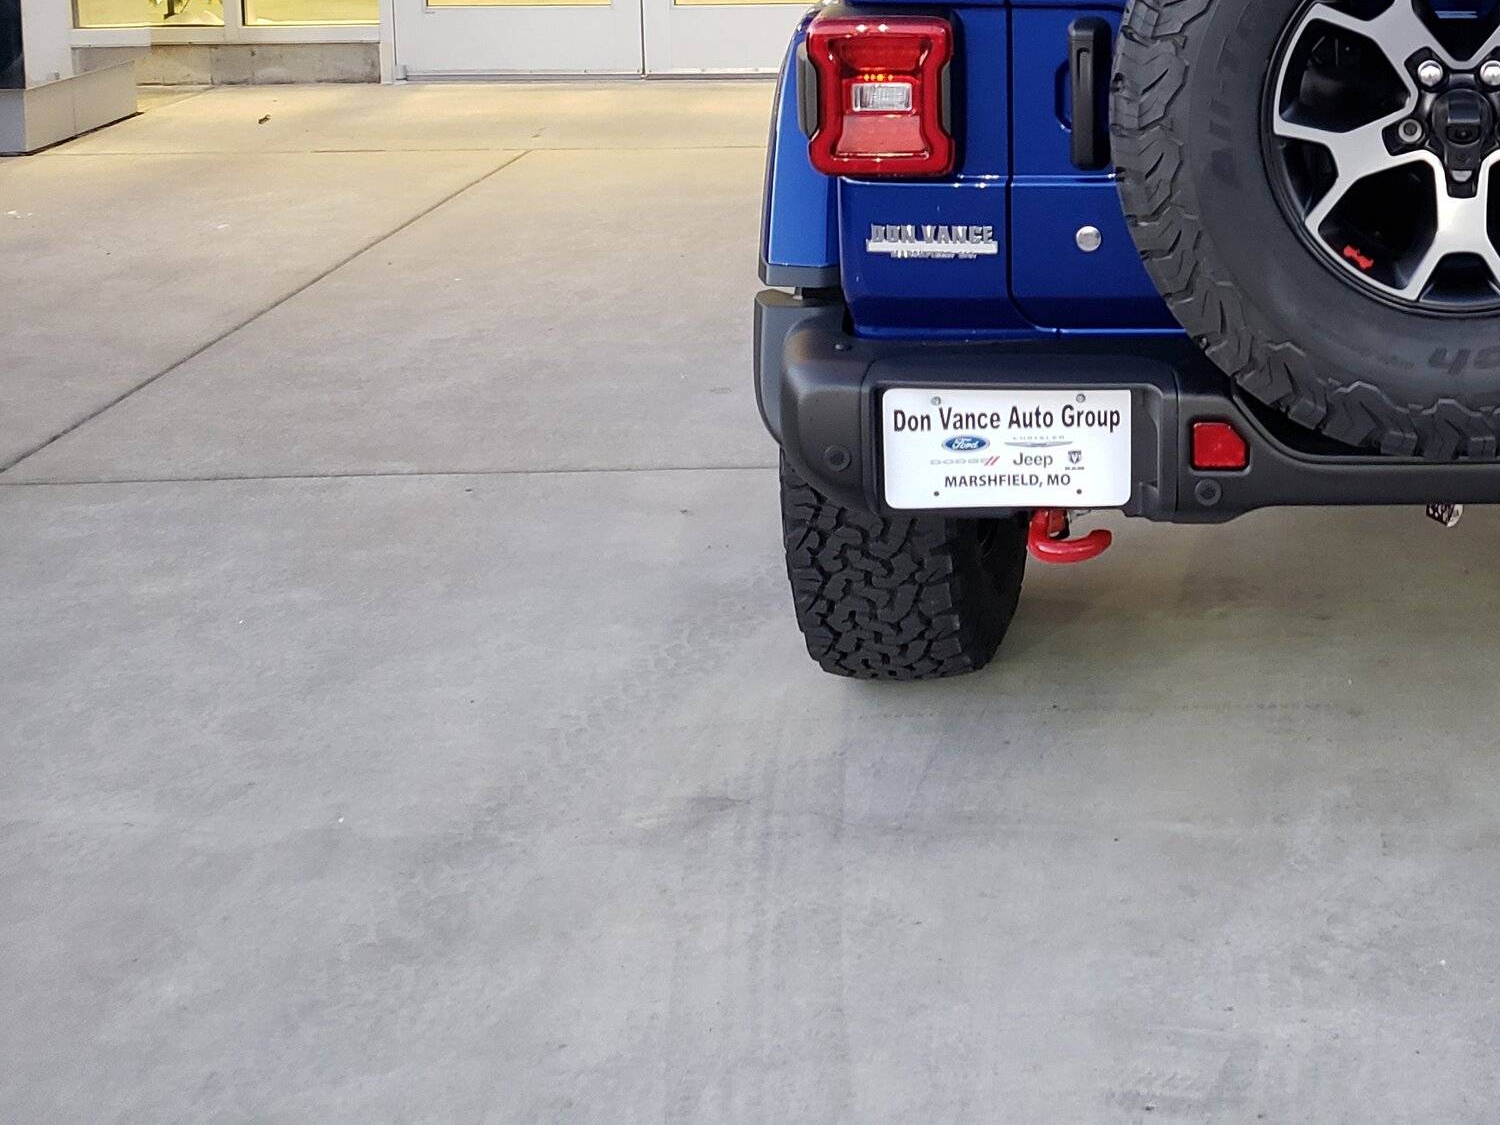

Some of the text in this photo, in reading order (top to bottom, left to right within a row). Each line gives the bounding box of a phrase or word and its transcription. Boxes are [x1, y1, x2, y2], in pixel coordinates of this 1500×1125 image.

[871, 224, 993, 244] DON VANCE
[893, 404, 1121, 433] Don Vance Auto Group
[1013, 452, 1053, 468] Jeep
[944, 474, 1071, 488] MARSHFIELD, MO
